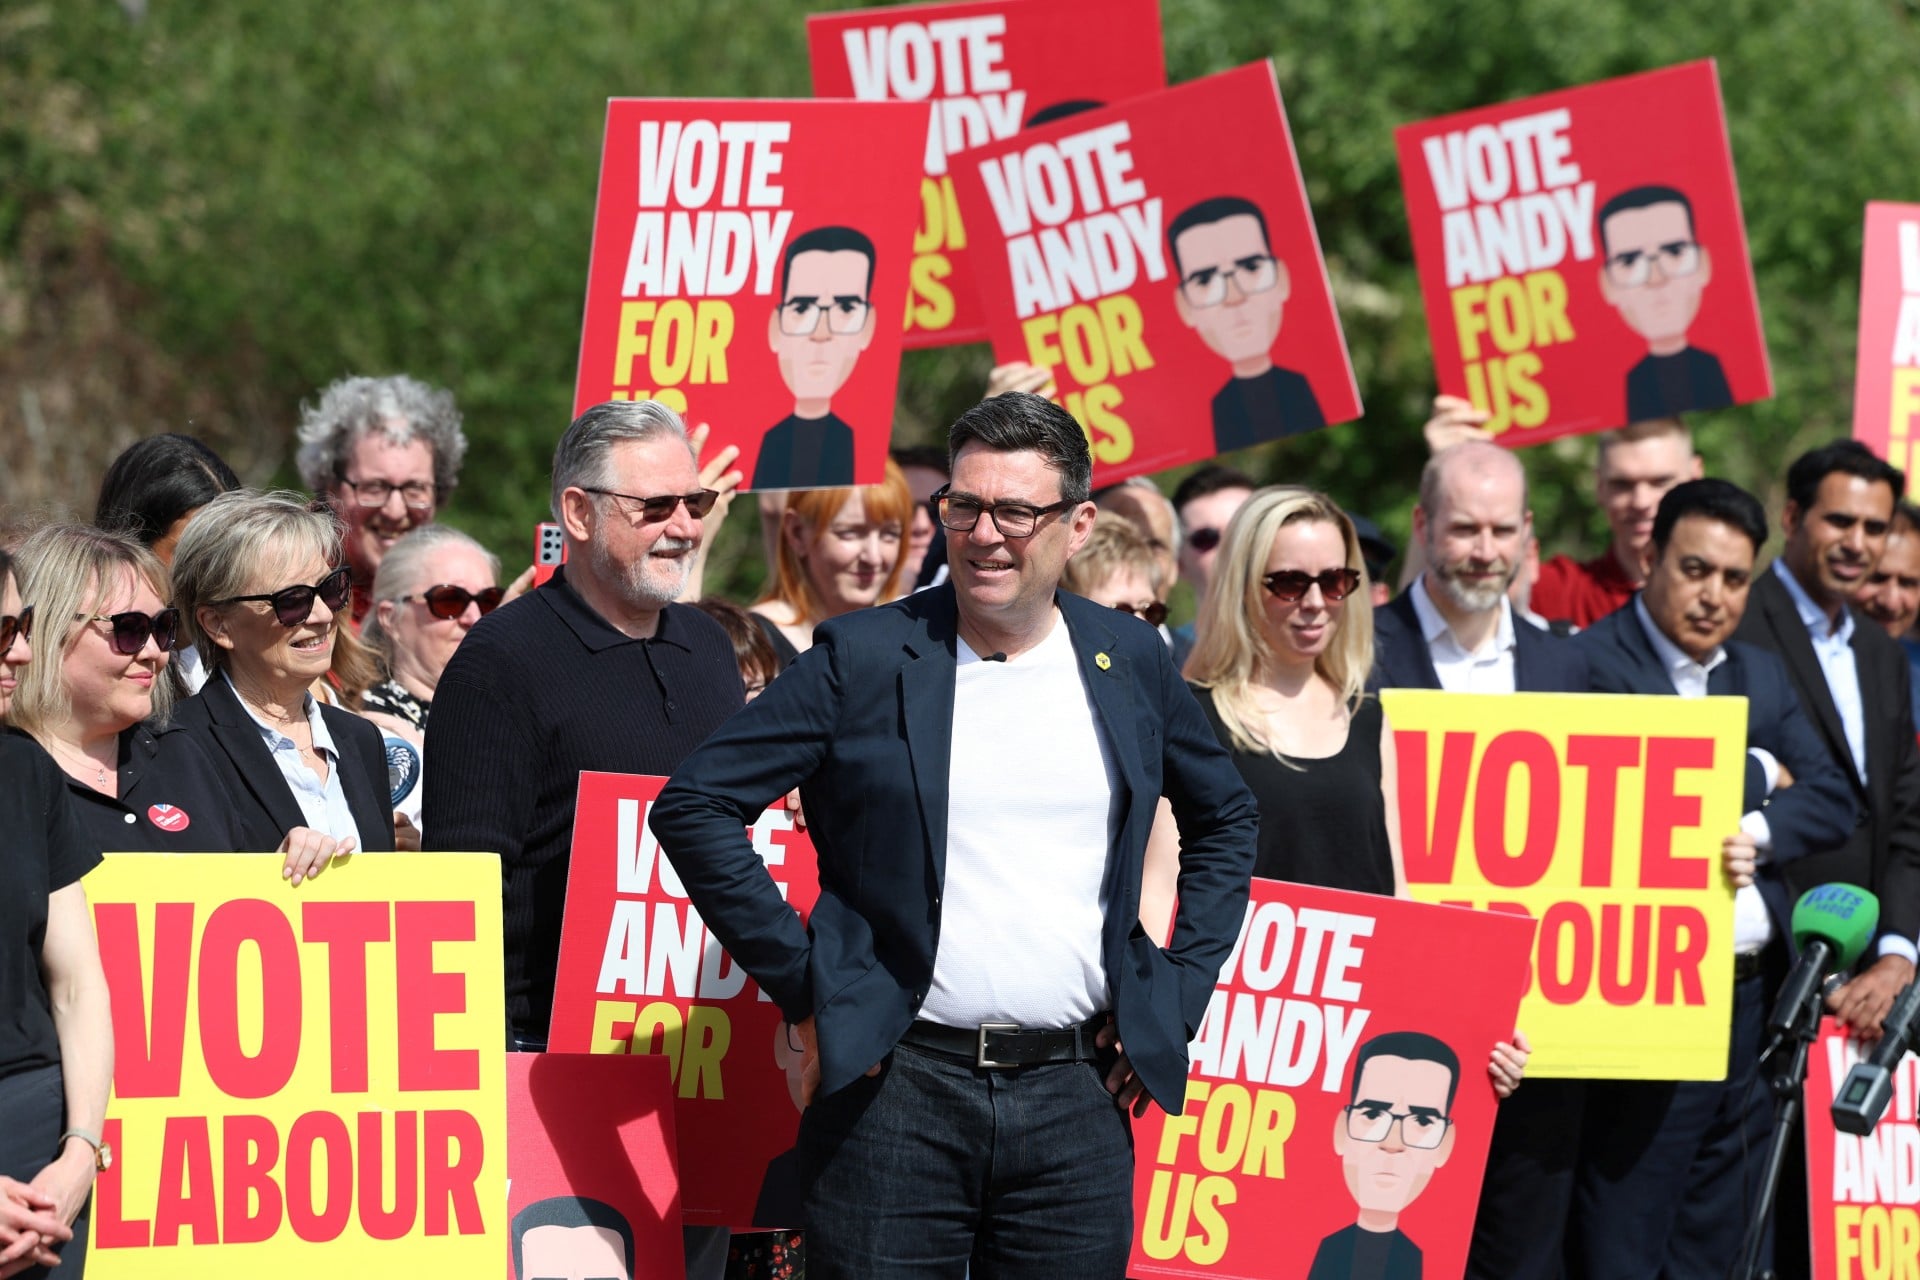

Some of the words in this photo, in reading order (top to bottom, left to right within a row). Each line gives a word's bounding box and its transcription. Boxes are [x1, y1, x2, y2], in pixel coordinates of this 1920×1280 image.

[842, 14, 1012, 101] VOTE
[639, 119, 791, 208] VOTE
[924, 89, 1027, 175] DY
[979, 120, 1147, 238] VOTE
[1422, 107, 1581, 211] VOTE
[621, 211, 794, 297] ANDY
[1006, 198, 1168, 319] ANDY
[1442, 181, 1596, 288] ANDY
[613, 299, 735, 386] FOR
[1021, 293, 1156, 388] FOR
[1451, 270, 1576, 361] FOR
[1464, 351, 1549, 435] US
[616, 798, 795, 900] VE
[1393, 730, 1716, 891] VOTE
[93, 898, 481, 1099] VOTE
[595, 899, 774, 1002] AND
[1439, 900, 1709, 1007] OUR
[590, 999, 732, 1100] FOR
[1187, 988, 1371, 1093] ANDY
[95, 1109, 486, 1250] LABOUR
[1156, 1079, 1297, 1180] FOR
[1833, 1122, 1920, 1205] AND
[1141, 1169, 1238, 1266] US
